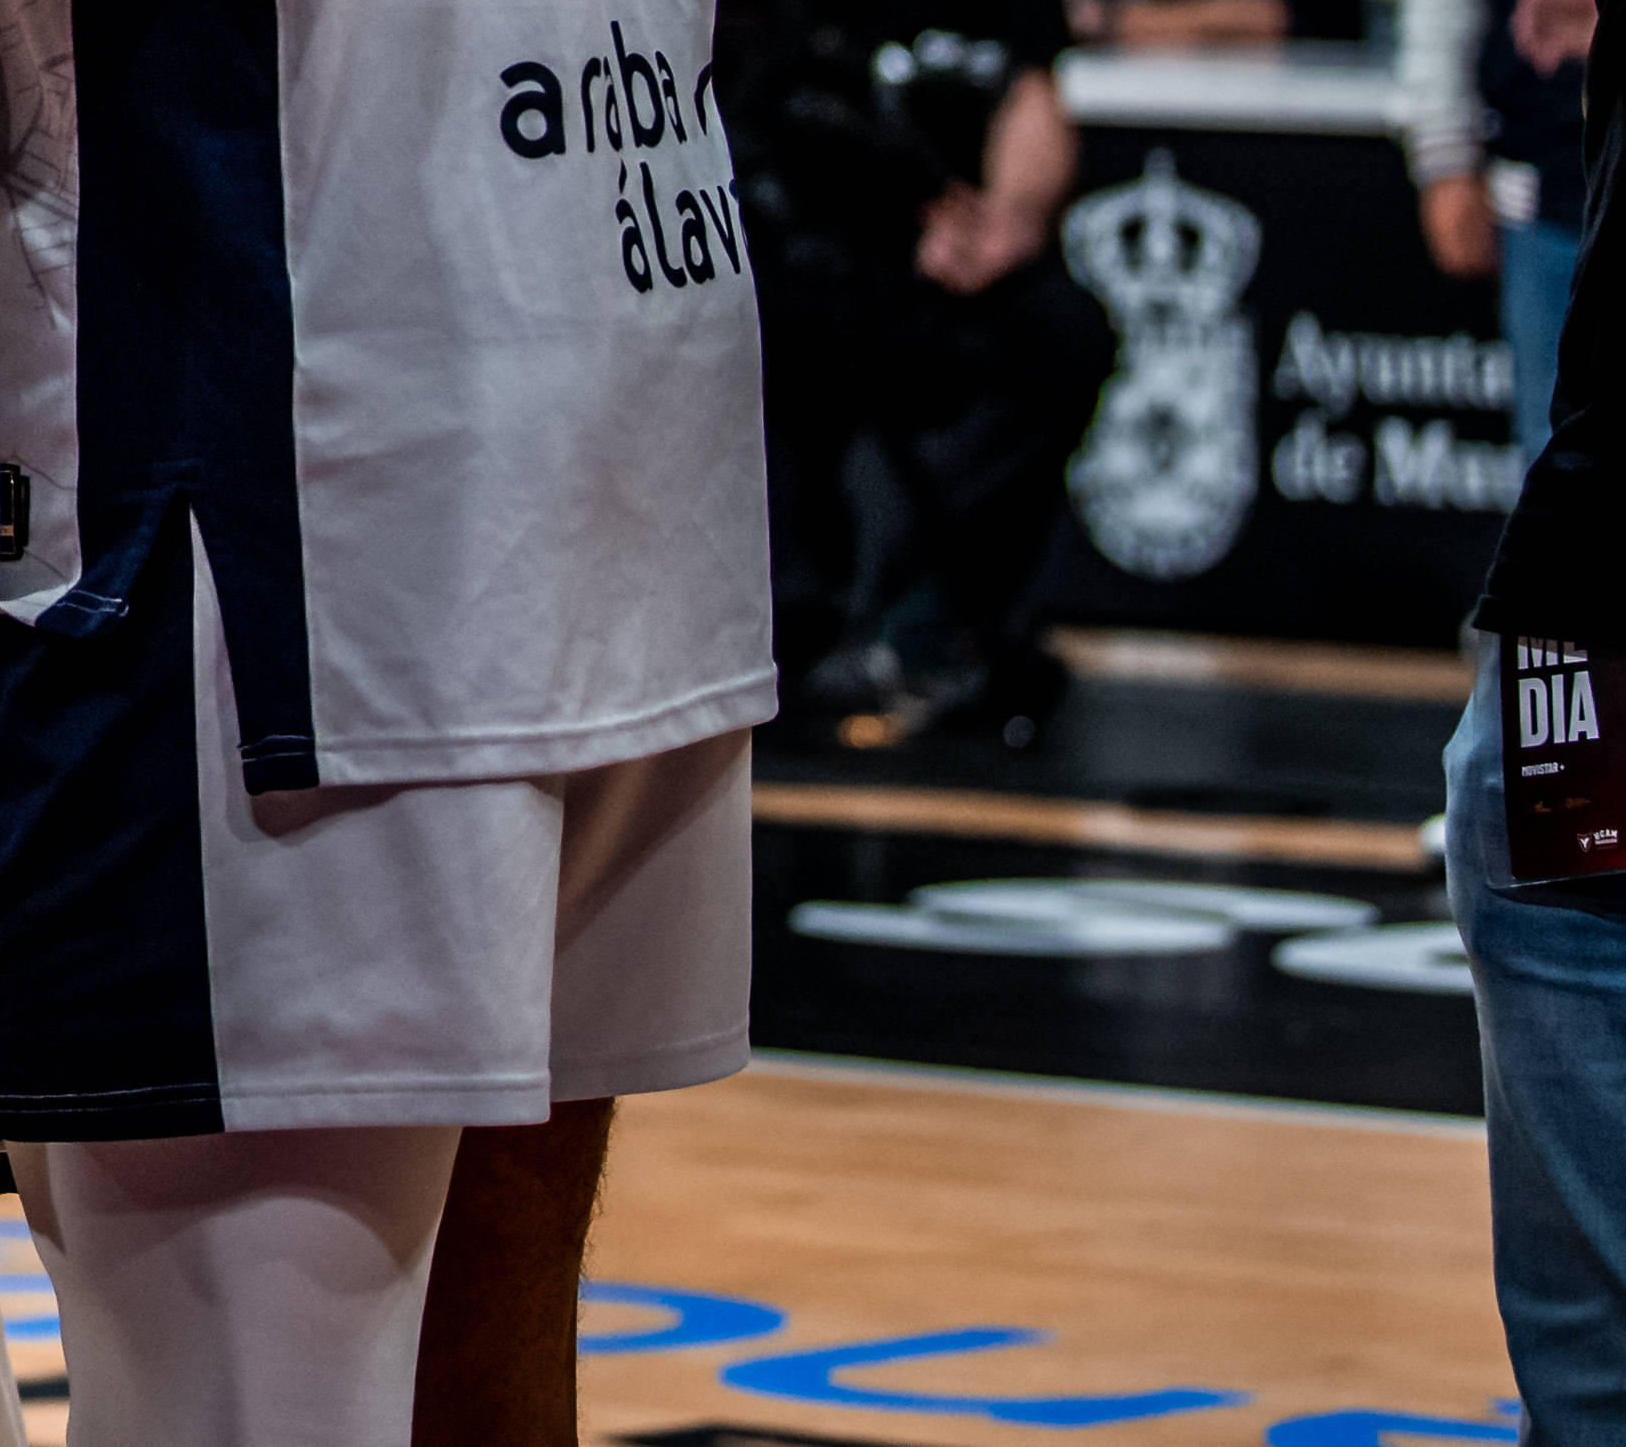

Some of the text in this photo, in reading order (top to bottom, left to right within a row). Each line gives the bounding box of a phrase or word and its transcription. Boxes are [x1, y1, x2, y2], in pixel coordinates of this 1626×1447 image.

[499, 20, 688, 160] araba
[615, 159, 745, 294] álav
[1518, 670, 1600, 749] DIA
